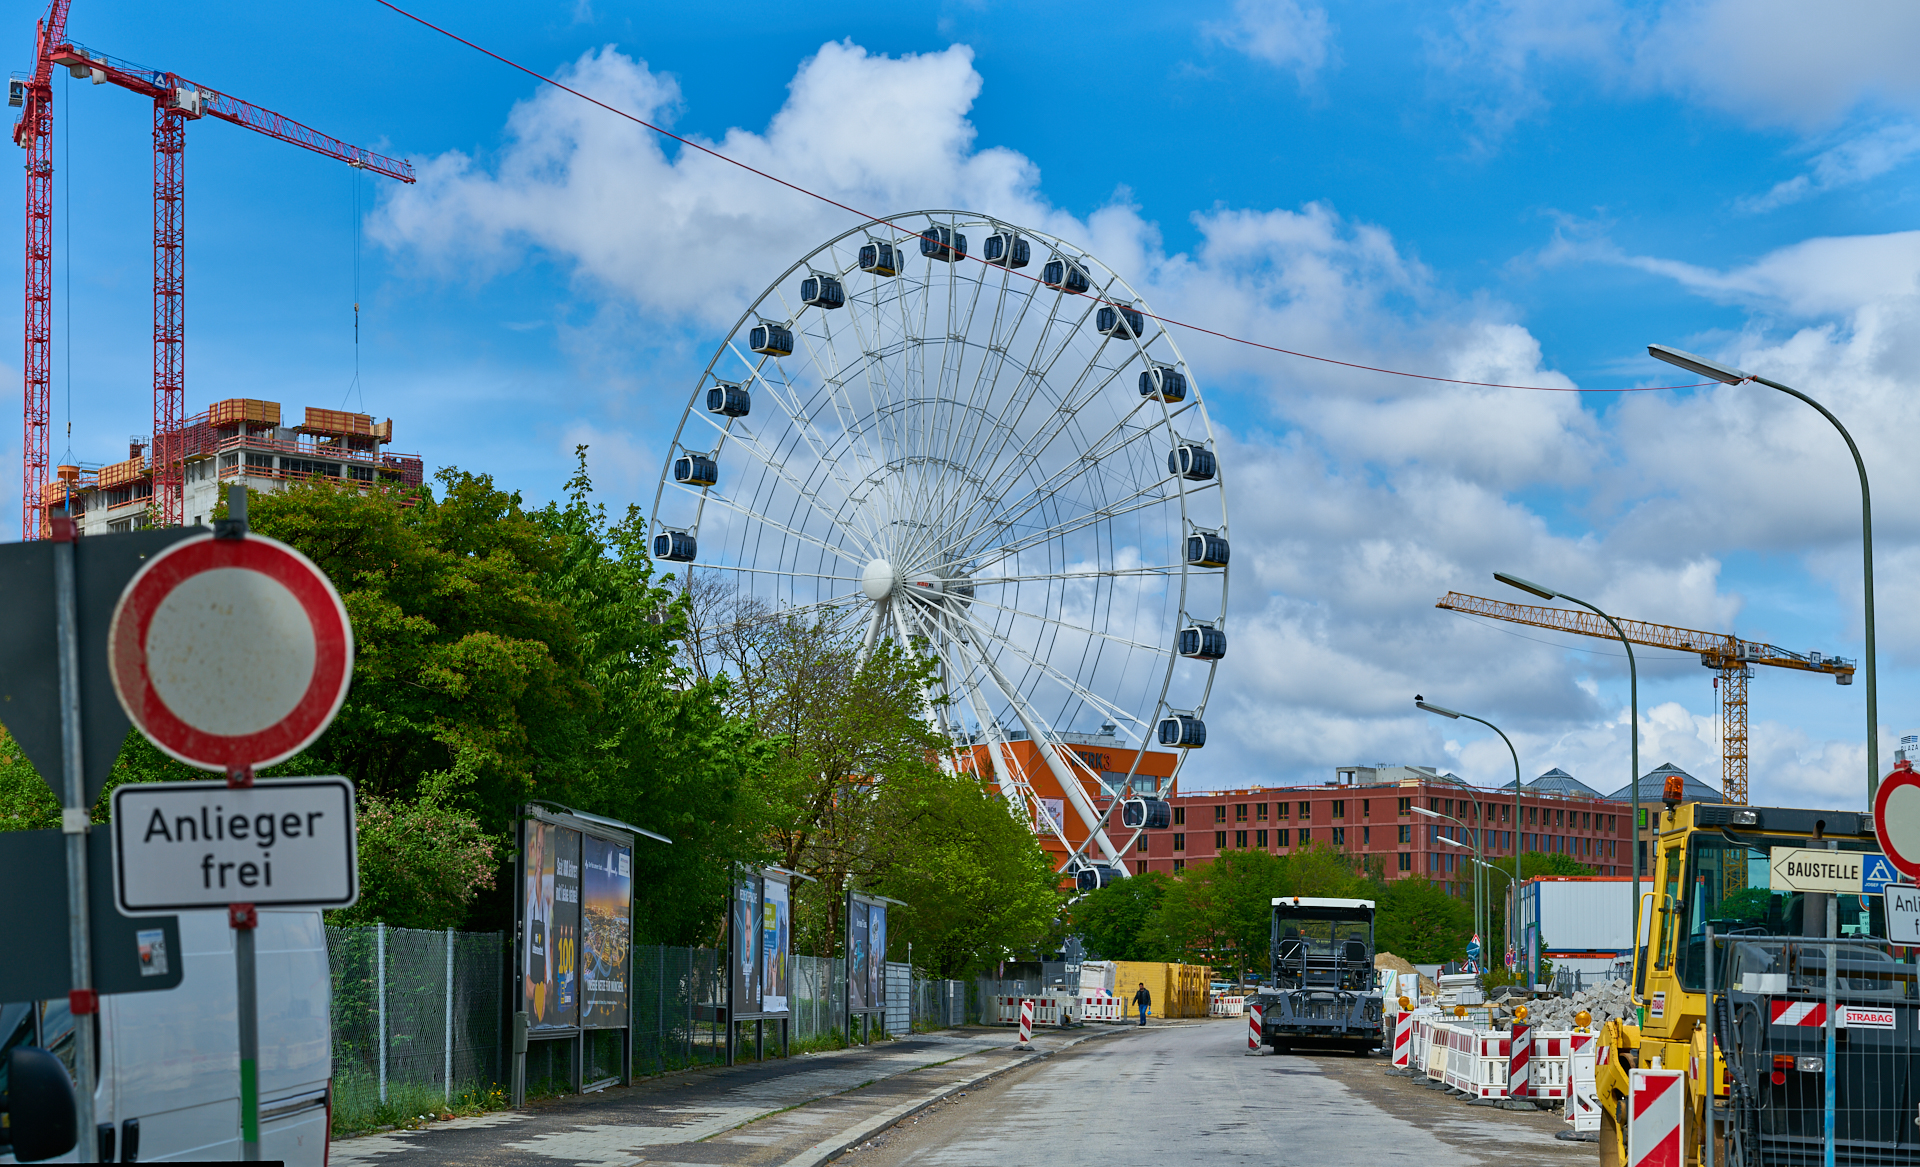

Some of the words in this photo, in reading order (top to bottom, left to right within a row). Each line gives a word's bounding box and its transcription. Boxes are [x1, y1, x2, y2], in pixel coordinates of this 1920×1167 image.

[144, 806, 324, 848] Anlieger
[201, 852, 273, 889] frei
[1787, 861, 1858, 880] BAUSTELLE
[1895, 894, 1920, 912] Anli
[558, 937, 574, 974] 100
[587, 979, 597, 991] UNSERE
[1846, 1012, 1893, 1023] STRABAG
